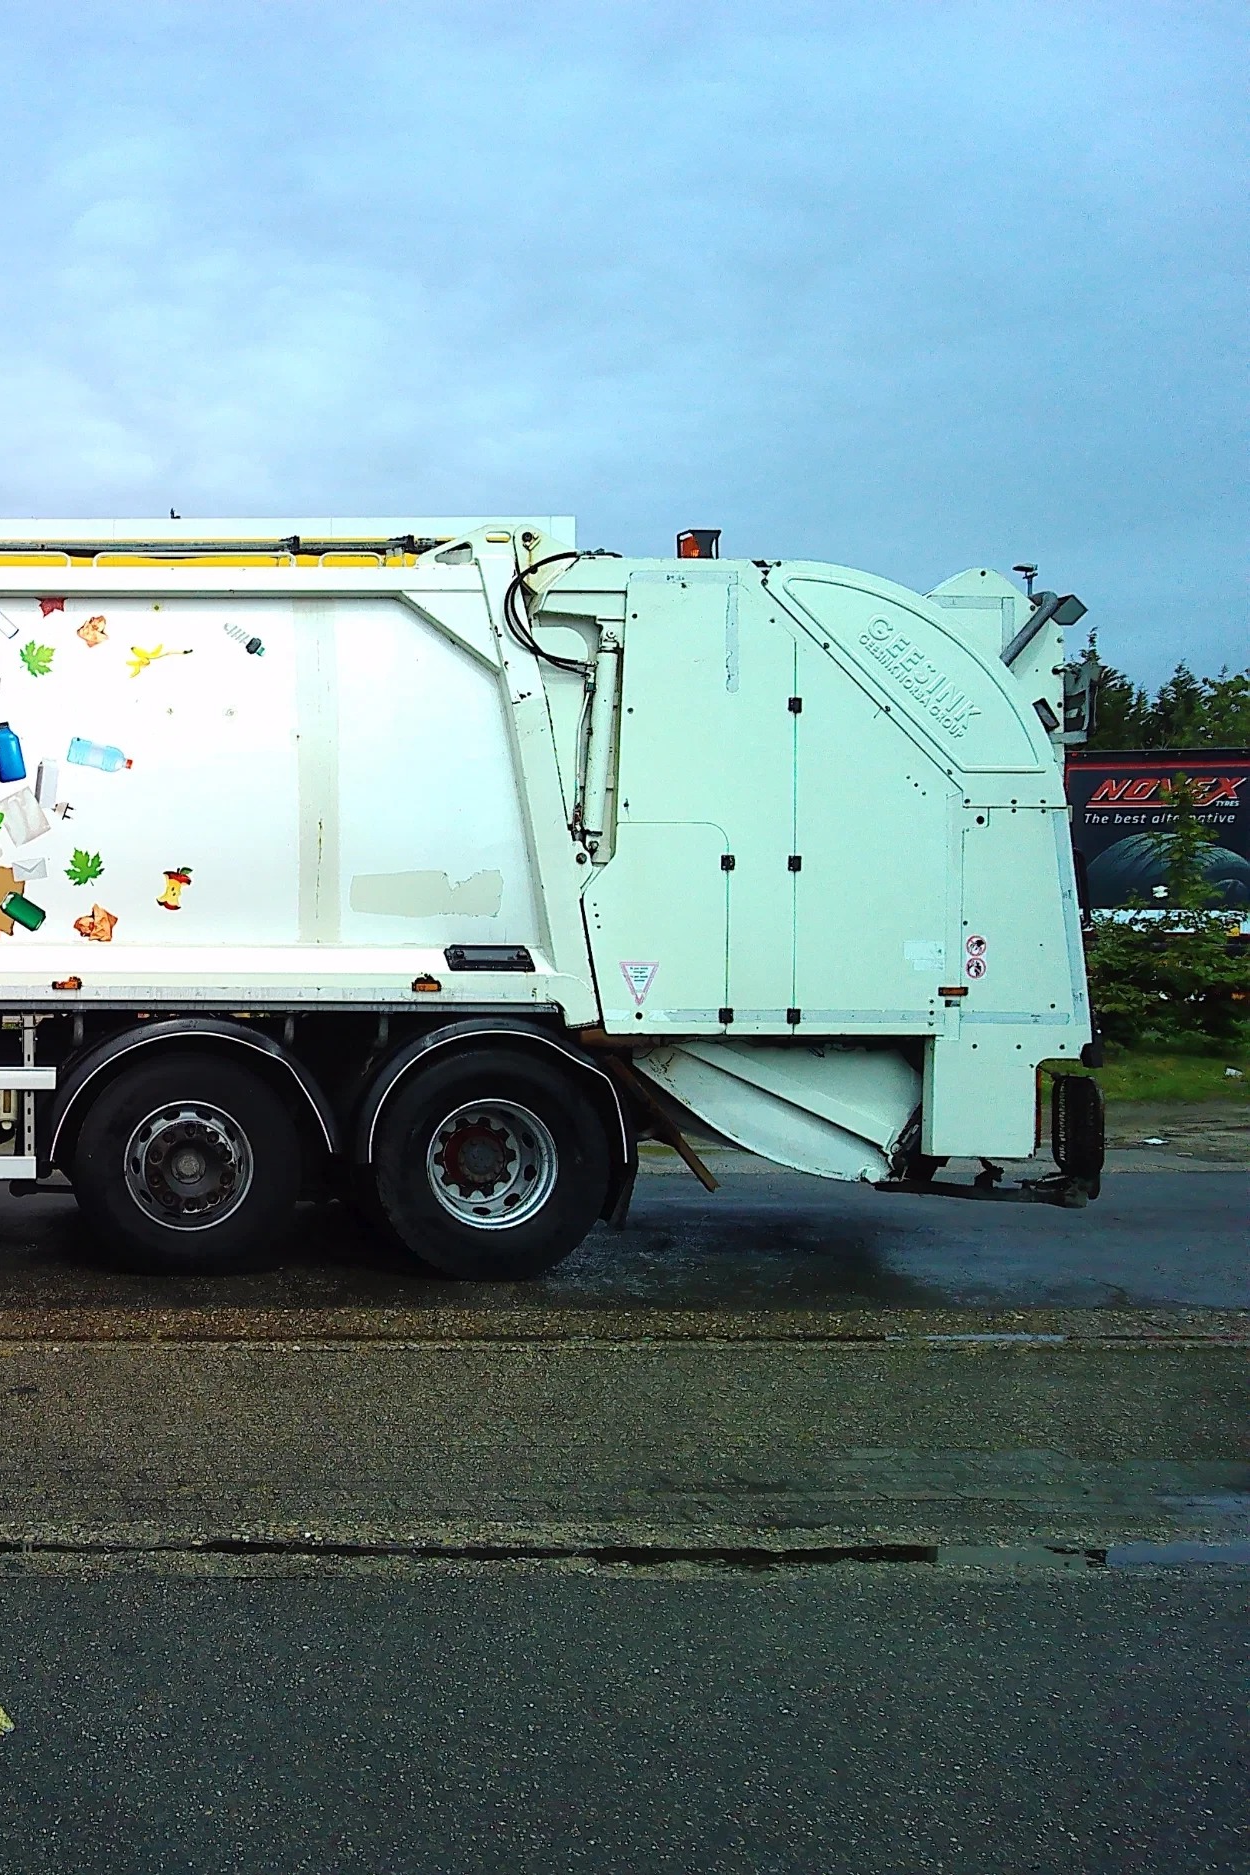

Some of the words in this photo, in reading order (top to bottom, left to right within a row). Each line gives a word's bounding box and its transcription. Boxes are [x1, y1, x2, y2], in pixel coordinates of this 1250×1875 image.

[867, 613, 982, 731] GEESINK
[1084, 813, 1110, 824] The
[1114, 813, 1147, 824] best
[1151, 812, 1236, 825] altenative
